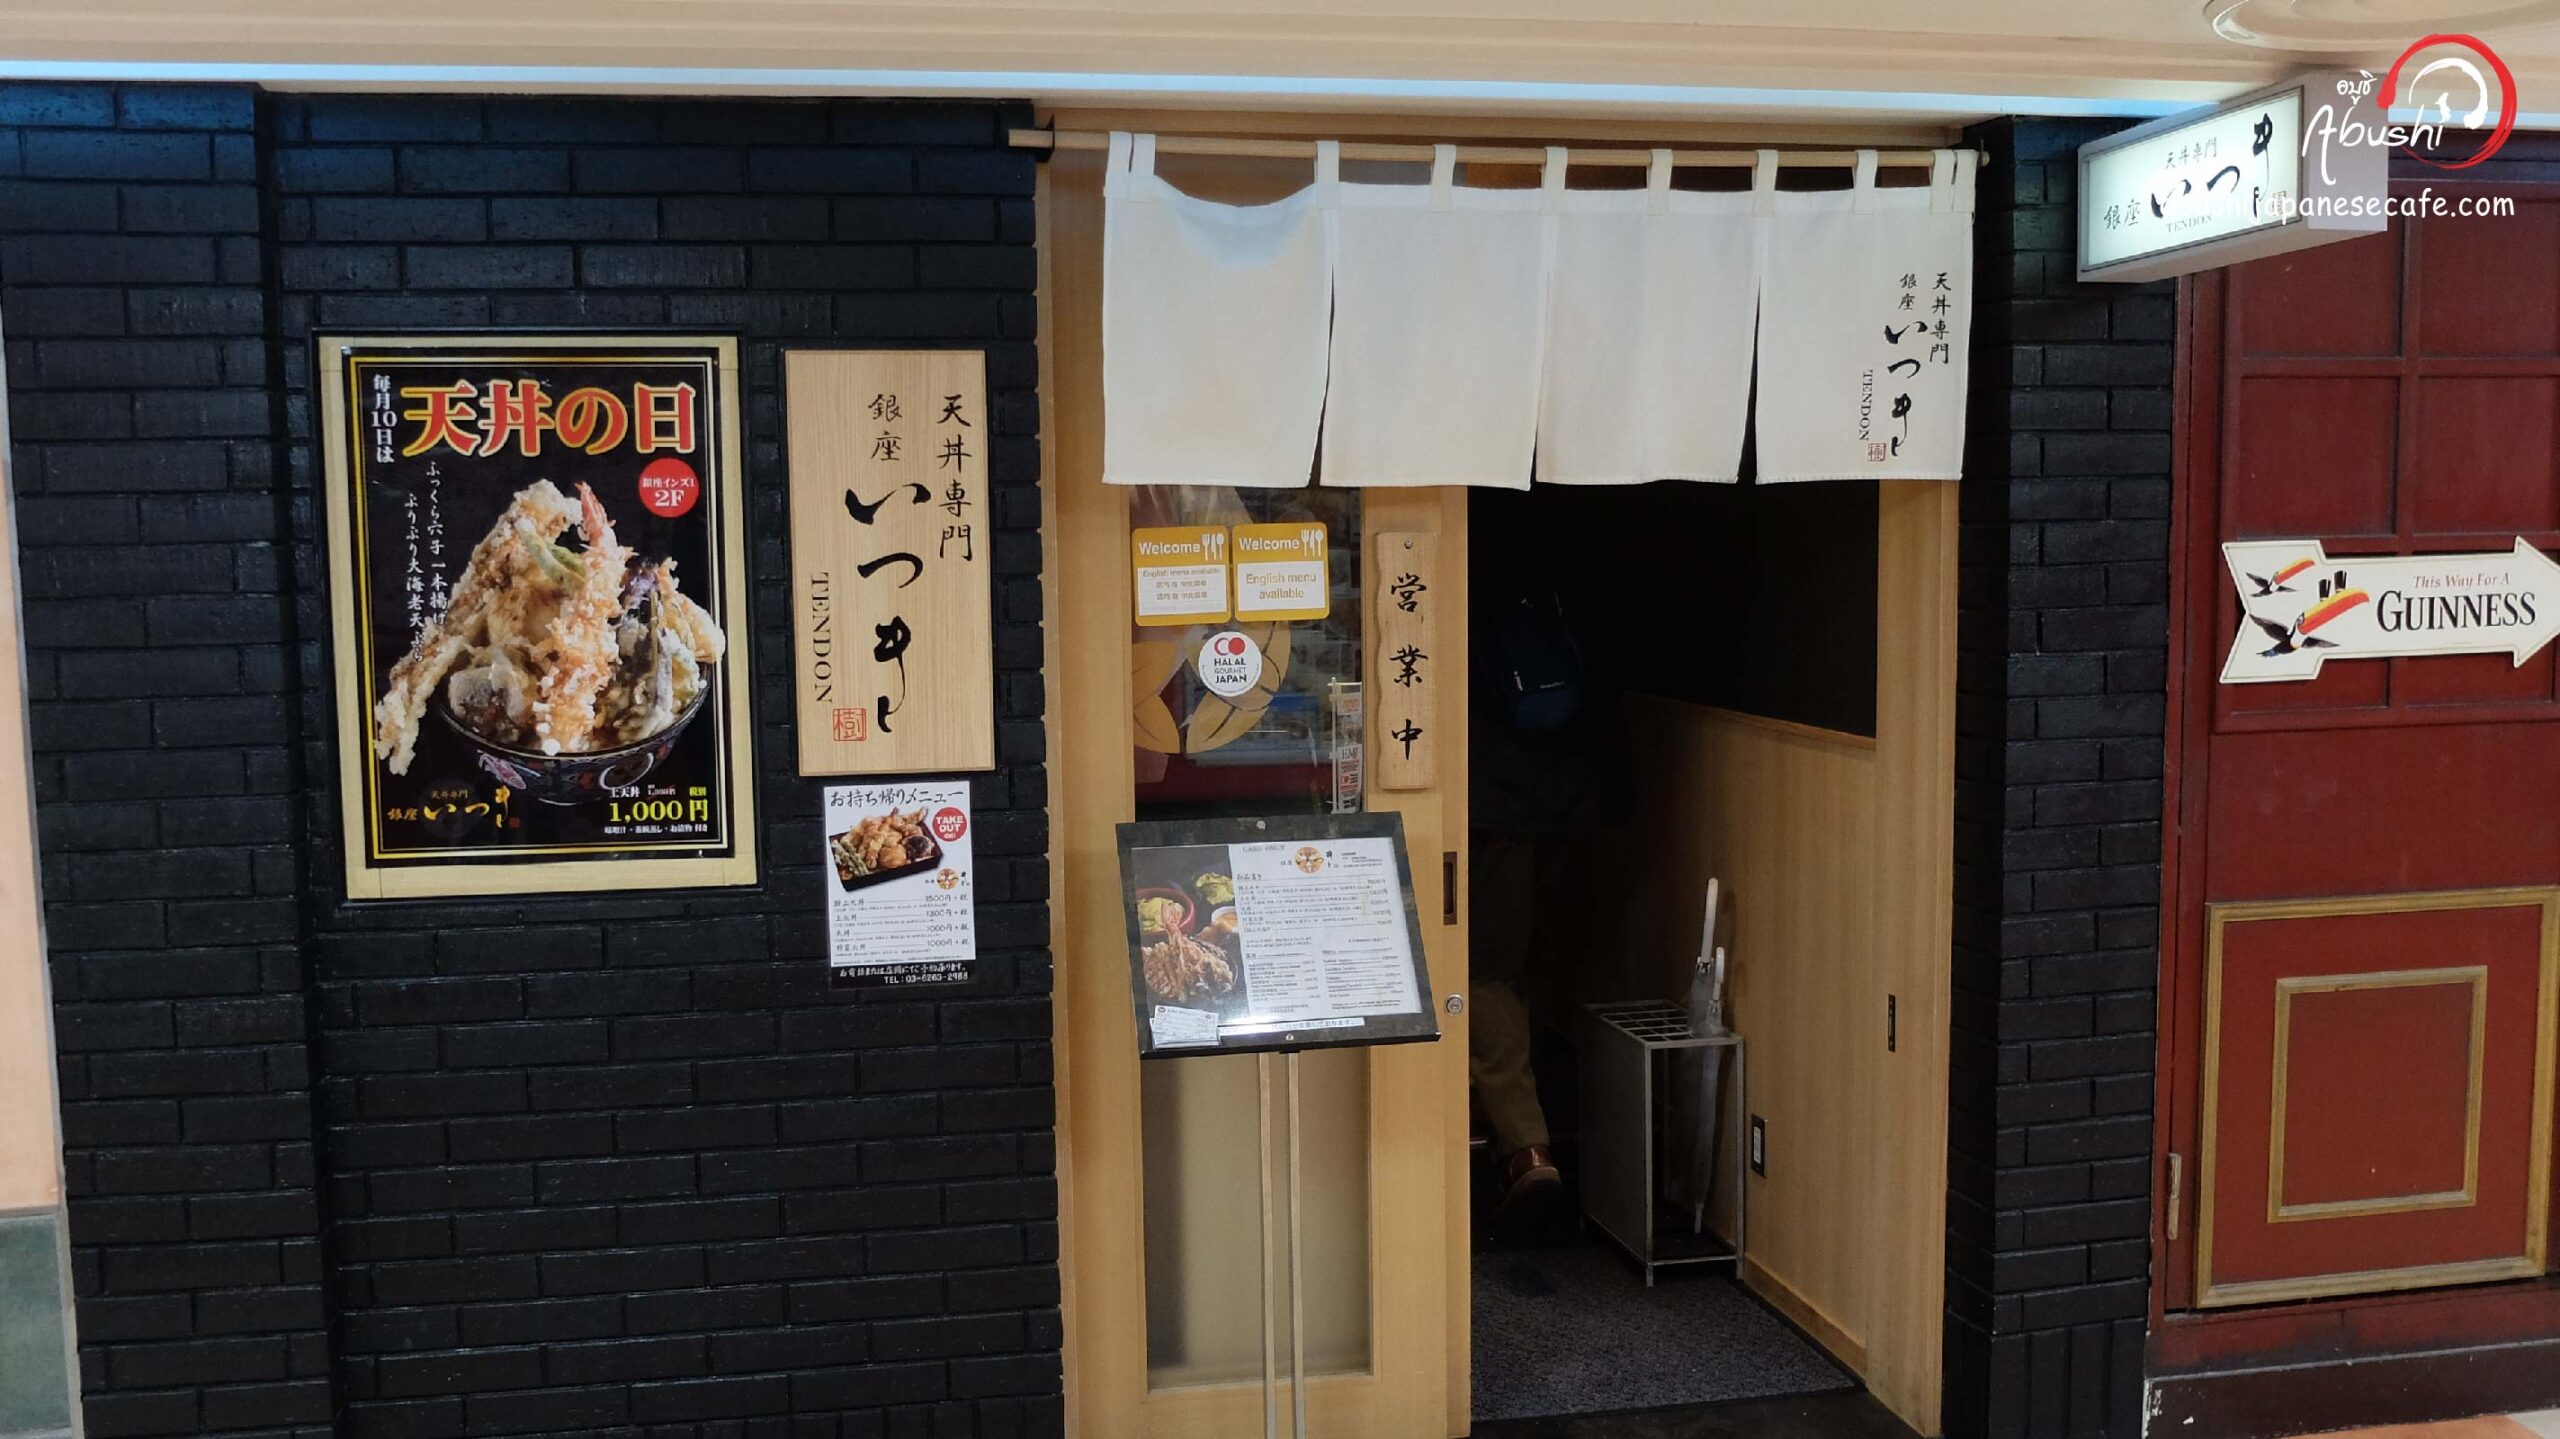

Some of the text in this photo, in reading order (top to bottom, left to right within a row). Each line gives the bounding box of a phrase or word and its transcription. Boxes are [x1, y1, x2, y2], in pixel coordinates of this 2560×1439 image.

[2104, 200, 2140, 230] 銀座
[1898, 273, 1917, 310] 銀座
[1929, 272, 1952, 364] 天丼専門
[1859, 369, 1873, 441] TENDON
[372, 374, 397, 463] 毎月10日は
[400, 378, 697, 458] 天丼の日
[868, 393, 903, 461] 銀座
[643, 477, 695, 488] 銀座インズ1
[937, 394, 974, 562] 天丼専門
[654, 489, 685, 507] 2F
[426, 461, 449, 625] ふっくら穴子一本揚げ
[1139, 541, 1201, 556] Welcome
[1239, 537, 1301, 552] Welcome
[1246, 572, 1317, 586] English menu
[2413, 572, 2511, 590] This Way For A
[1259, 587, 1304, 600] available
[2376, 590, 2536, 632] GUINNESS
[811, 572, 833, 703] TENDON
[1214, 657, 1247, 667] HALAL
[1389, 572, 1429, 761] 営業中
[1215, 674, 1247, 684] JAPAN
[830, 788, 965, 808] お持ち帰りメニュー
[935, 815, 965, 825] TAKE
[938, 824, 961, 833] OUT
